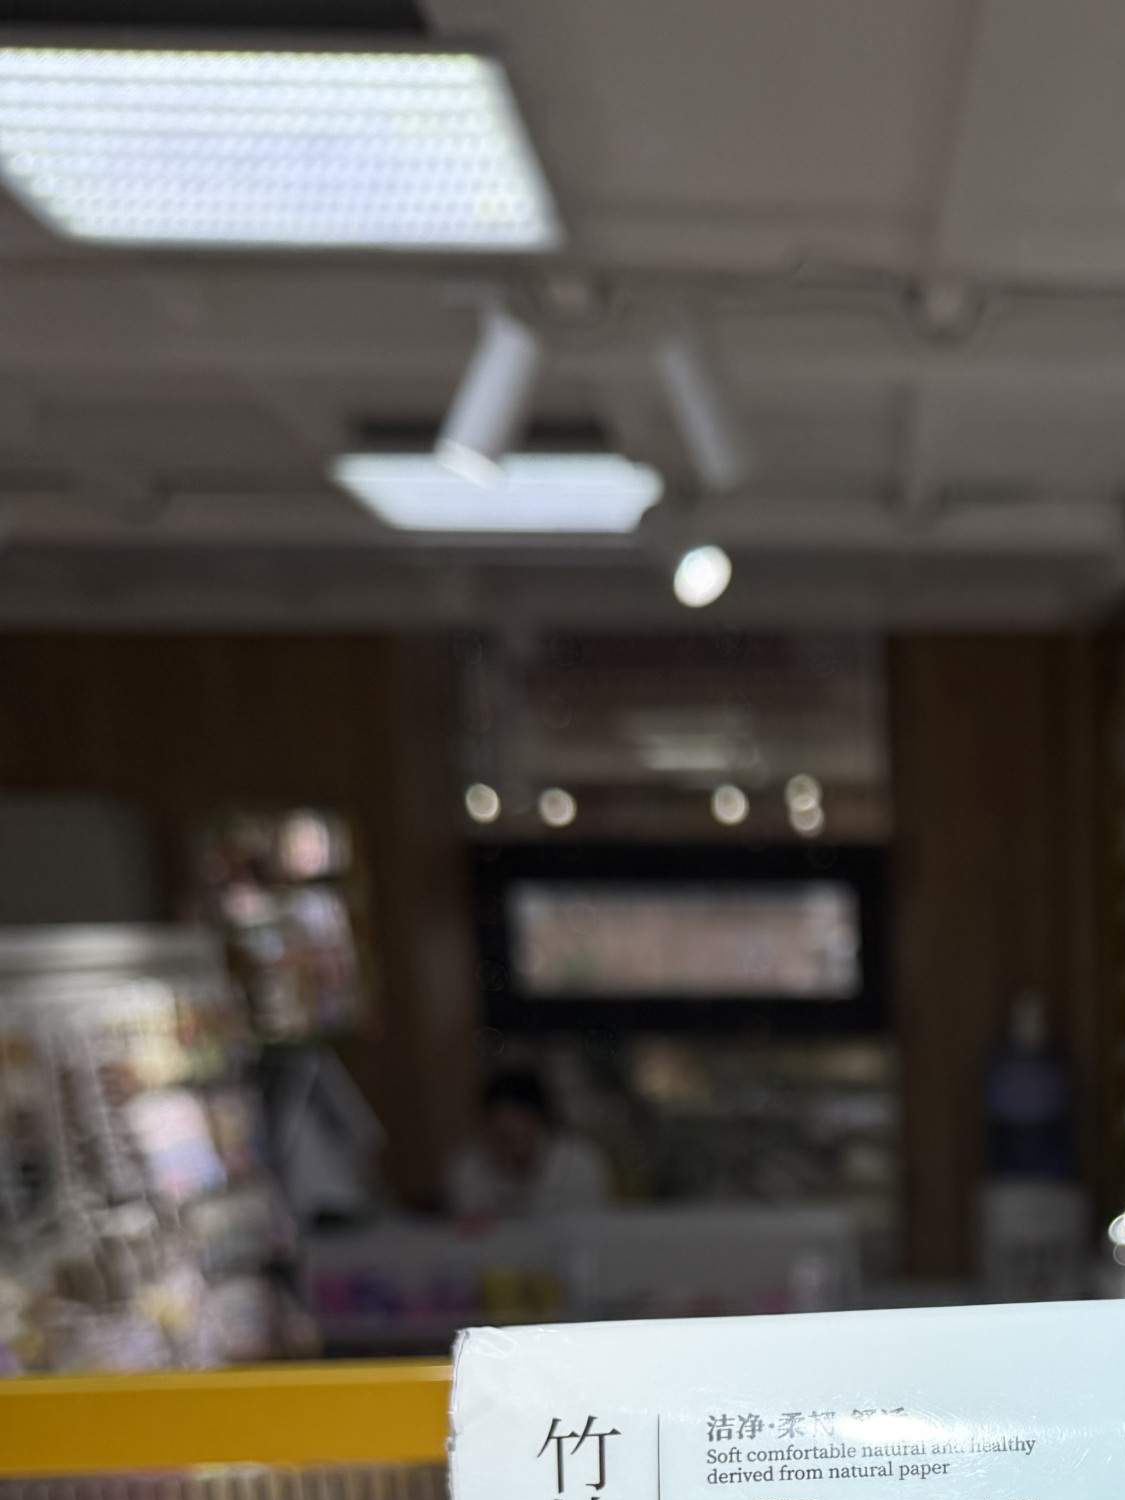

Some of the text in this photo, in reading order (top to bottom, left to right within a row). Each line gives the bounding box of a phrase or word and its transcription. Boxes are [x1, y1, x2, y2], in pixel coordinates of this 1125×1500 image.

[706, 1446, 742, 1465] Soft
[746, 1443, 857, 1463] comfortable
[861, 1440, 926, 1459] natural
[970, 1435, 1037, 1456] healthy
[706, 1461, 951, 1485] derived from natural paper
